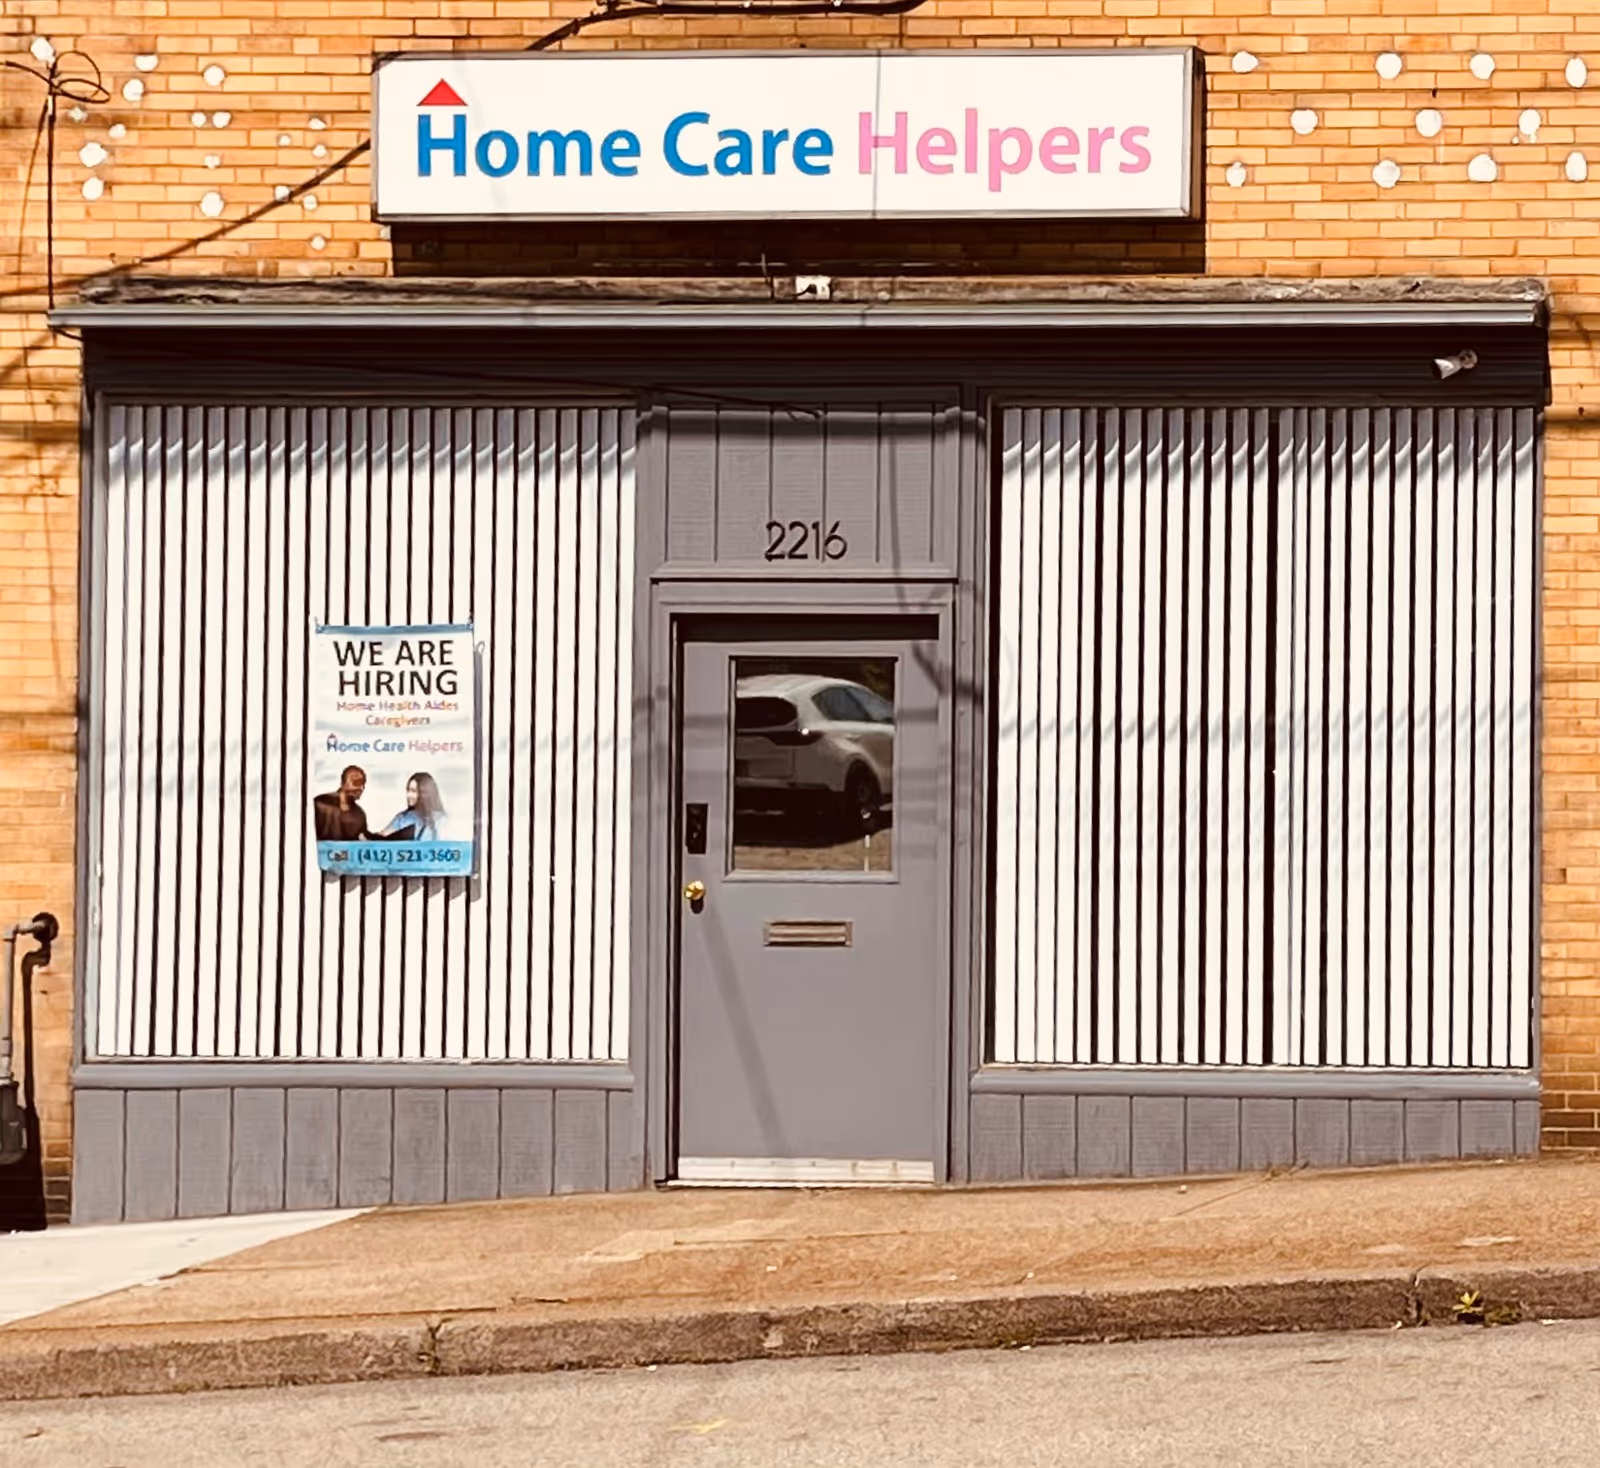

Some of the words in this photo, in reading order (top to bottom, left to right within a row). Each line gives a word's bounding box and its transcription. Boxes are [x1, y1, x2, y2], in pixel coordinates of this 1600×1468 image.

[417, 113, 640, 178] Home
[663, 111, 834, 177] Care
[858, 108, 1152, 192] Helpers
[765, 520, 848, 561] 2216
[333, 640, 384, 667] WE
[395, 640, 454, 666] ARE
[338, 669, 458, 697] HIRING
[336, 701, 375, 711] Home
[379, 700, 421, 711] Health
[424, 700, 459, 711] Aides
[365, 714, 431, 727] Caregivers
[326, 736, 370, 752] Home
[373, 739, 406, 752] Care
[408, 739, 464, 754] Helpers
[357, 848, 393, 864] (412)
